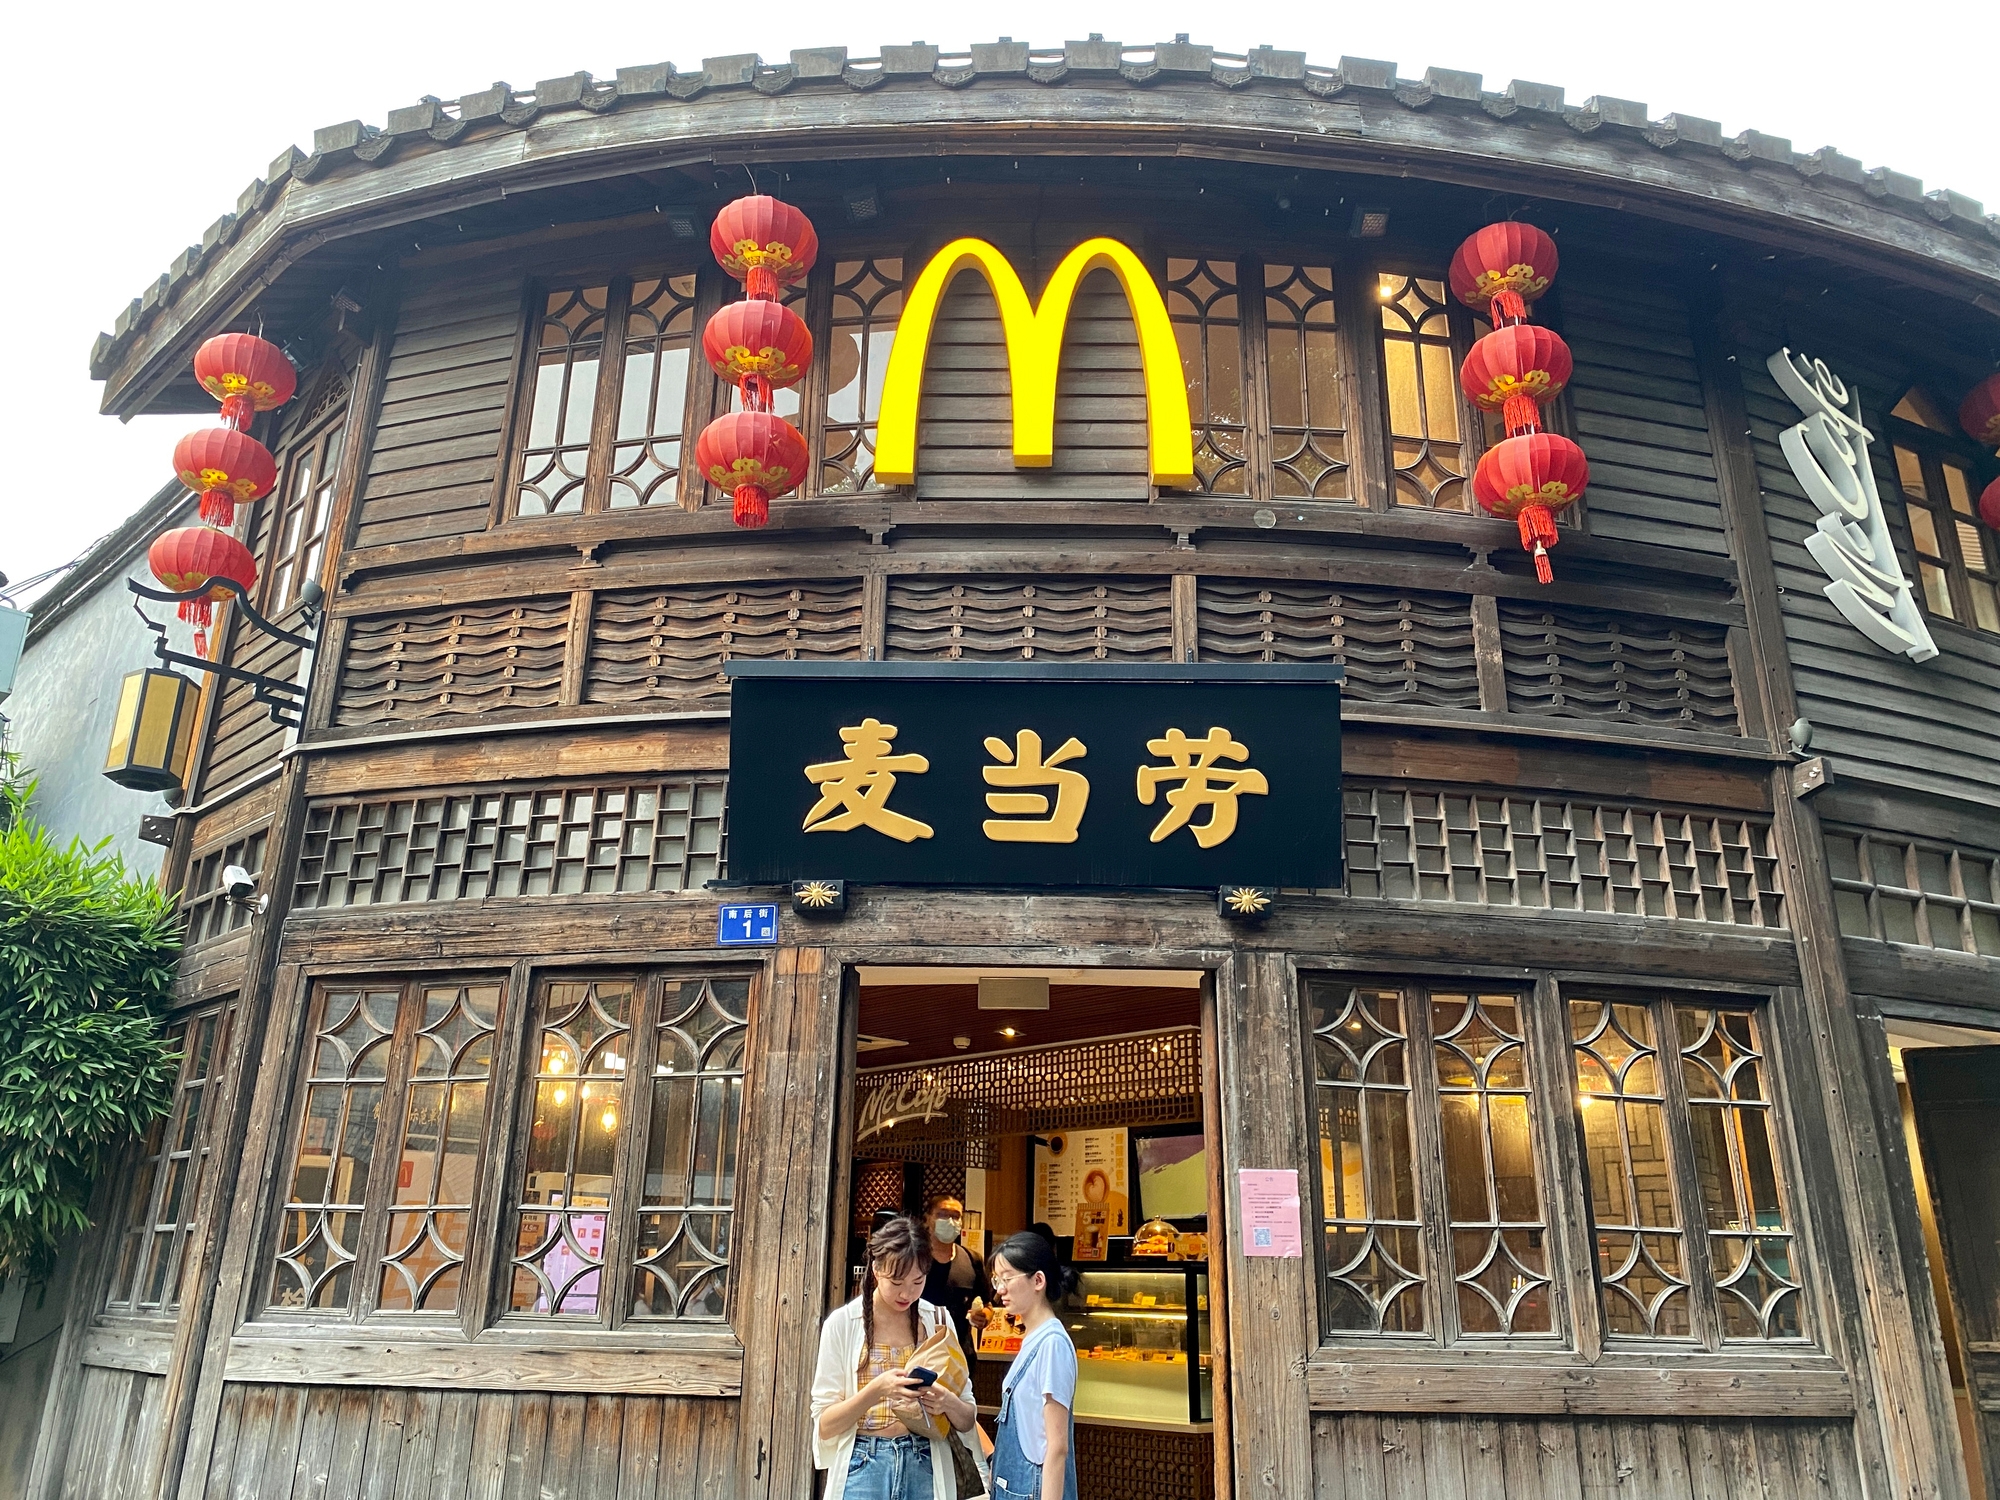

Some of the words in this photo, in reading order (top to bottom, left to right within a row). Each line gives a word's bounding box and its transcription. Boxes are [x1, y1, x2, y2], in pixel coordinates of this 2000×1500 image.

[802, 717, 1269, 850] 麦当劳
[728, 908, 769, 919] 南后街
[742, 919, 752, 938] 1
